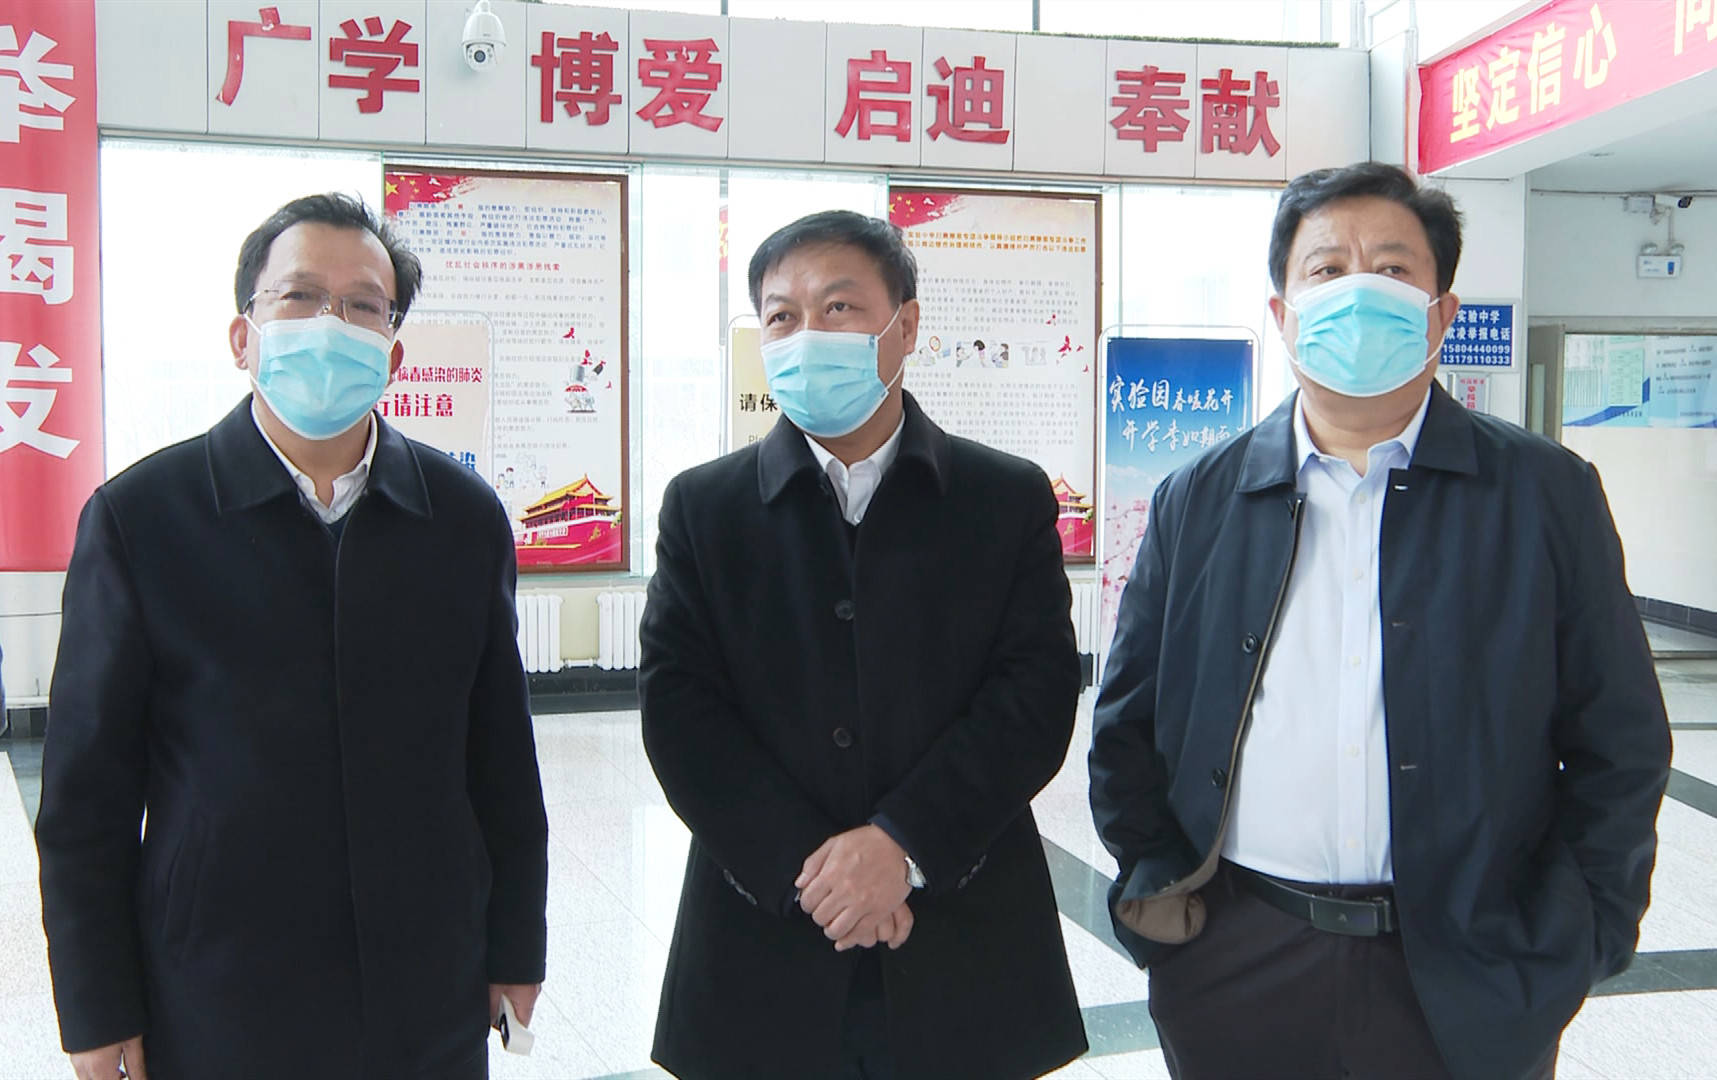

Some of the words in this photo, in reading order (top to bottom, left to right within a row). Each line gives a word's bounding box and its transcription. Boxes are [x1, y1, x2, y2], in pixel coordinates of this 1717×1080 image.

[217, 7, 419, 112] 广学
[531, 31, 724, 132] 博爱
[835, 50, 1010, 145] 启迪
[1111, 66, 1280, 157] 奉献
[1450, 3, 1617, 144] 坚定信心
[1443, 343, 1511, 354] 15804440099
[1443, 354, 1511, 365] 13179110333
[391, 366, 483, 383] 病毒感染的肺炎
[1122, 418, 1247, 452] 开学季如期而
